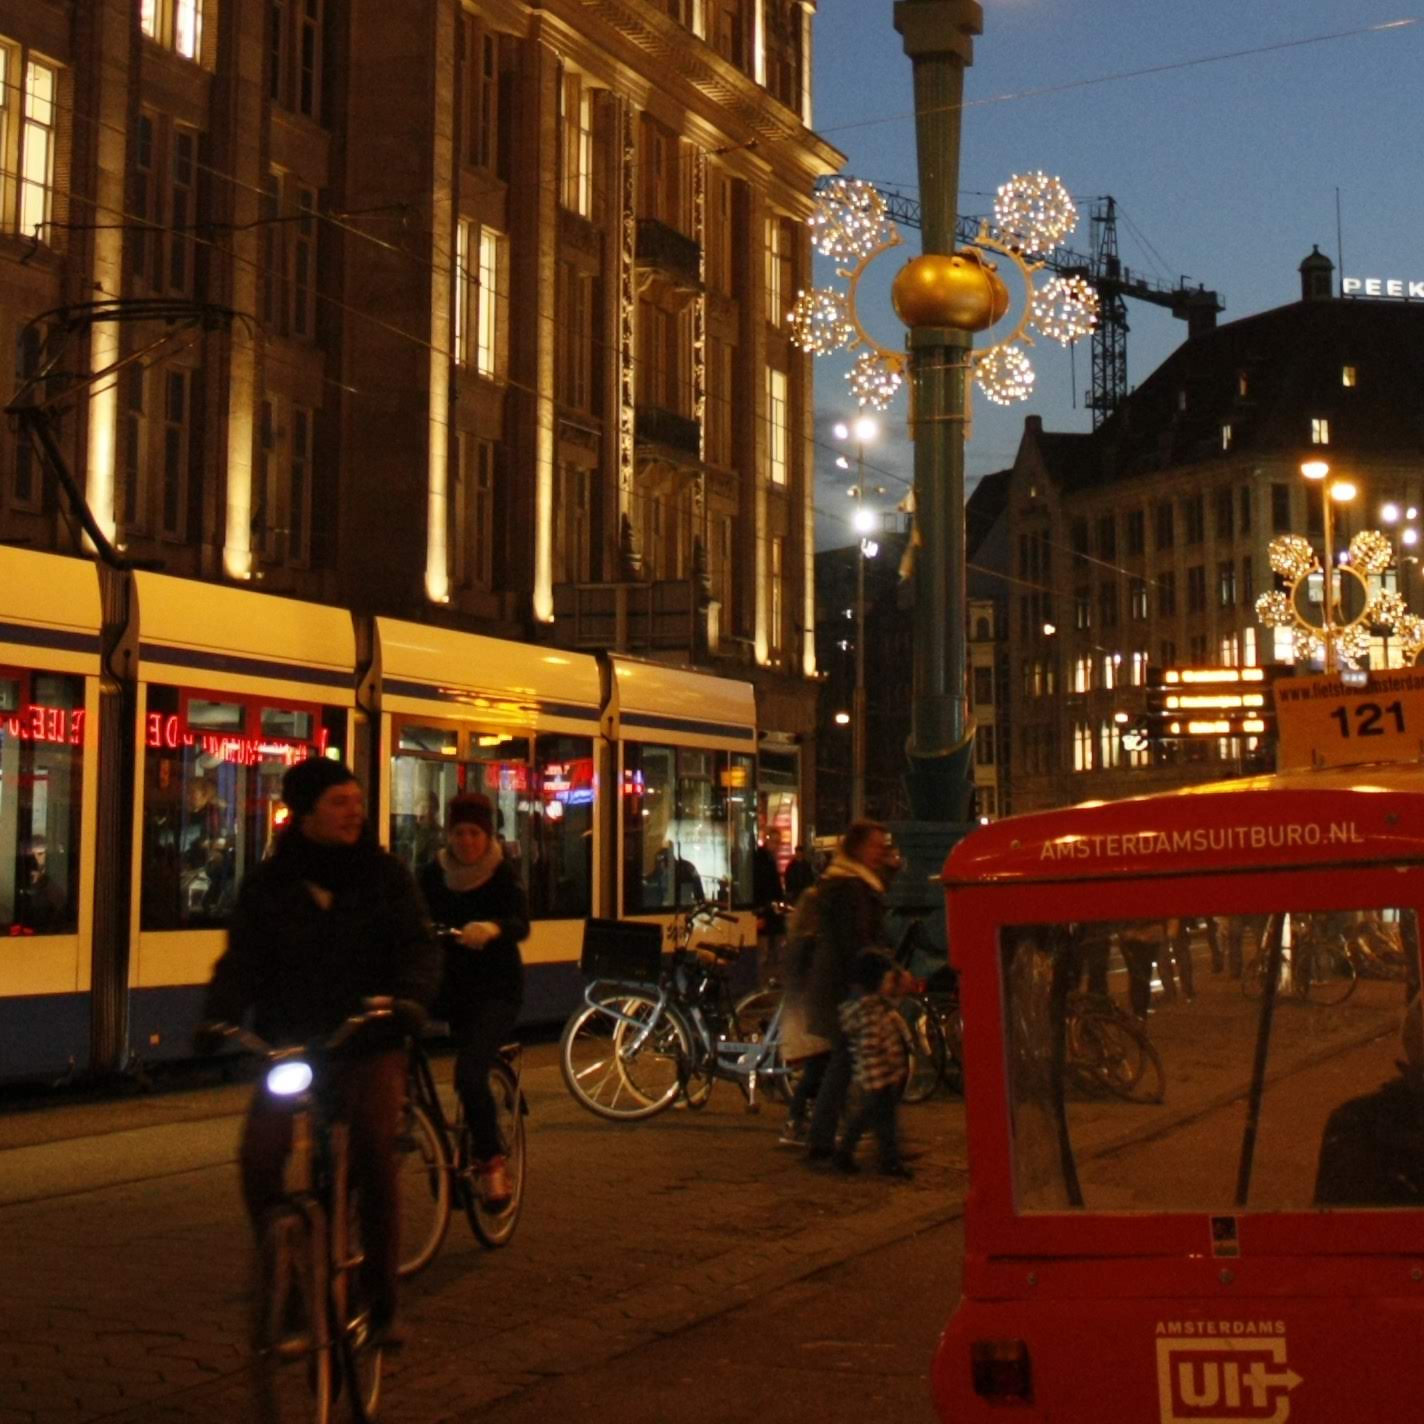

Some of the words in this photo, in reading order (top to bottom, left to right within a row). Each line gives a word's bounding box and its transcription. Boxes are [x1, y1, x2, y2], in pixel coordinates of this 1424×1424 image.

[1330, 700, 1406, 738] 121
[1039, 821, 1365, 862] AMSTERDAMSUITBURO.NL
[1155, 1320, 1287, 1335] AMSTERDAMS
